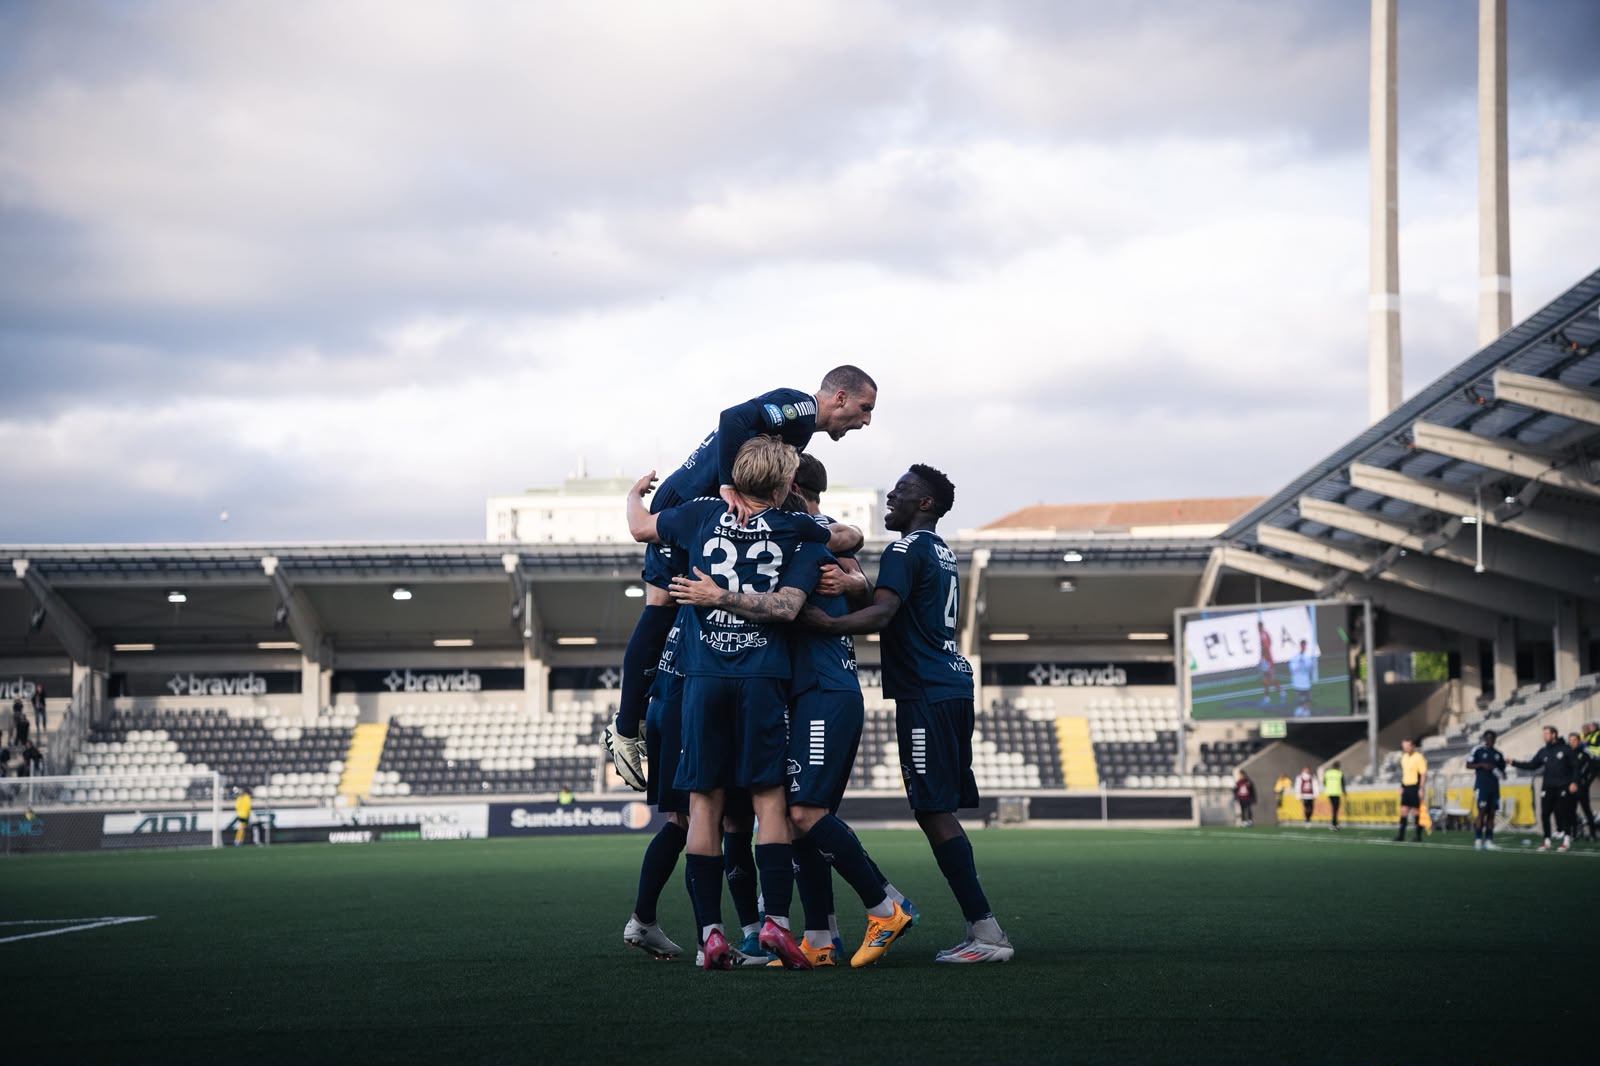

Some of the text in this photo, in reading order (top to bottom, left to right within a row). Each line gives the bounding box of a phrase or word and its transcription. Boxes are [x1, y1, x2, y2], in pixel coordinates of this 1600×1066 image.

[713, 525, 772, 540] SECURITY
[702, 537, 784, 595] 33
[943, 575, 958, 629] 4
[188, 672, 267, 695] bravida
[404, 668, 482, 692] bravida
[1049, 663, 1127, 686] bravida
[511, 807, 622, 828] Sundström
[329, 831, 372, 844] UNIBET
